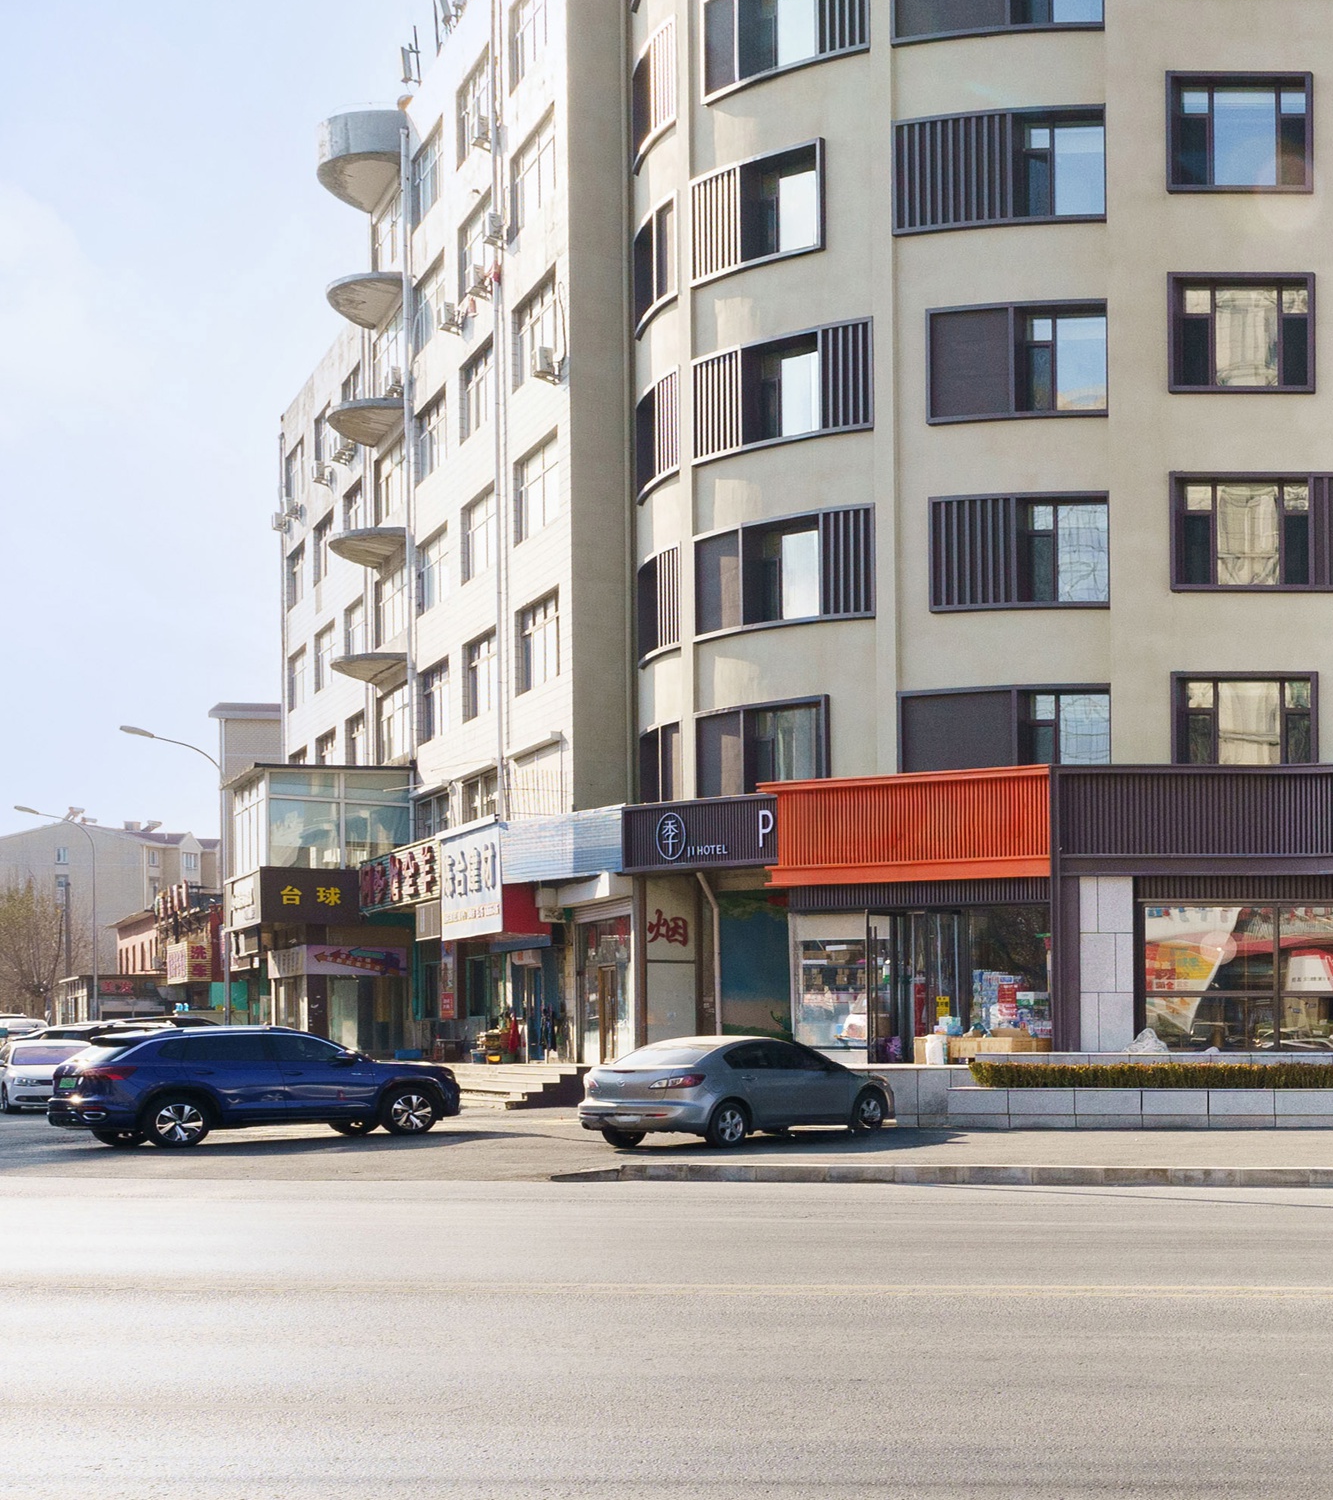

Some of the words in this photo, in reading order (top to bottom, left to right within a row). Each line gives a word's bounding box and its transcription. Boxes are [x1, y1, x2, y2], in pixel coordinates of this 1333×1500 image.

[661, 819, 679, 856] 季
[687, 846, 695, 858] JI
[696, 844, 728, 855] HOTEL
[280, 885, 342, 906] 台球
[647, 908, 689, 948] 烟
